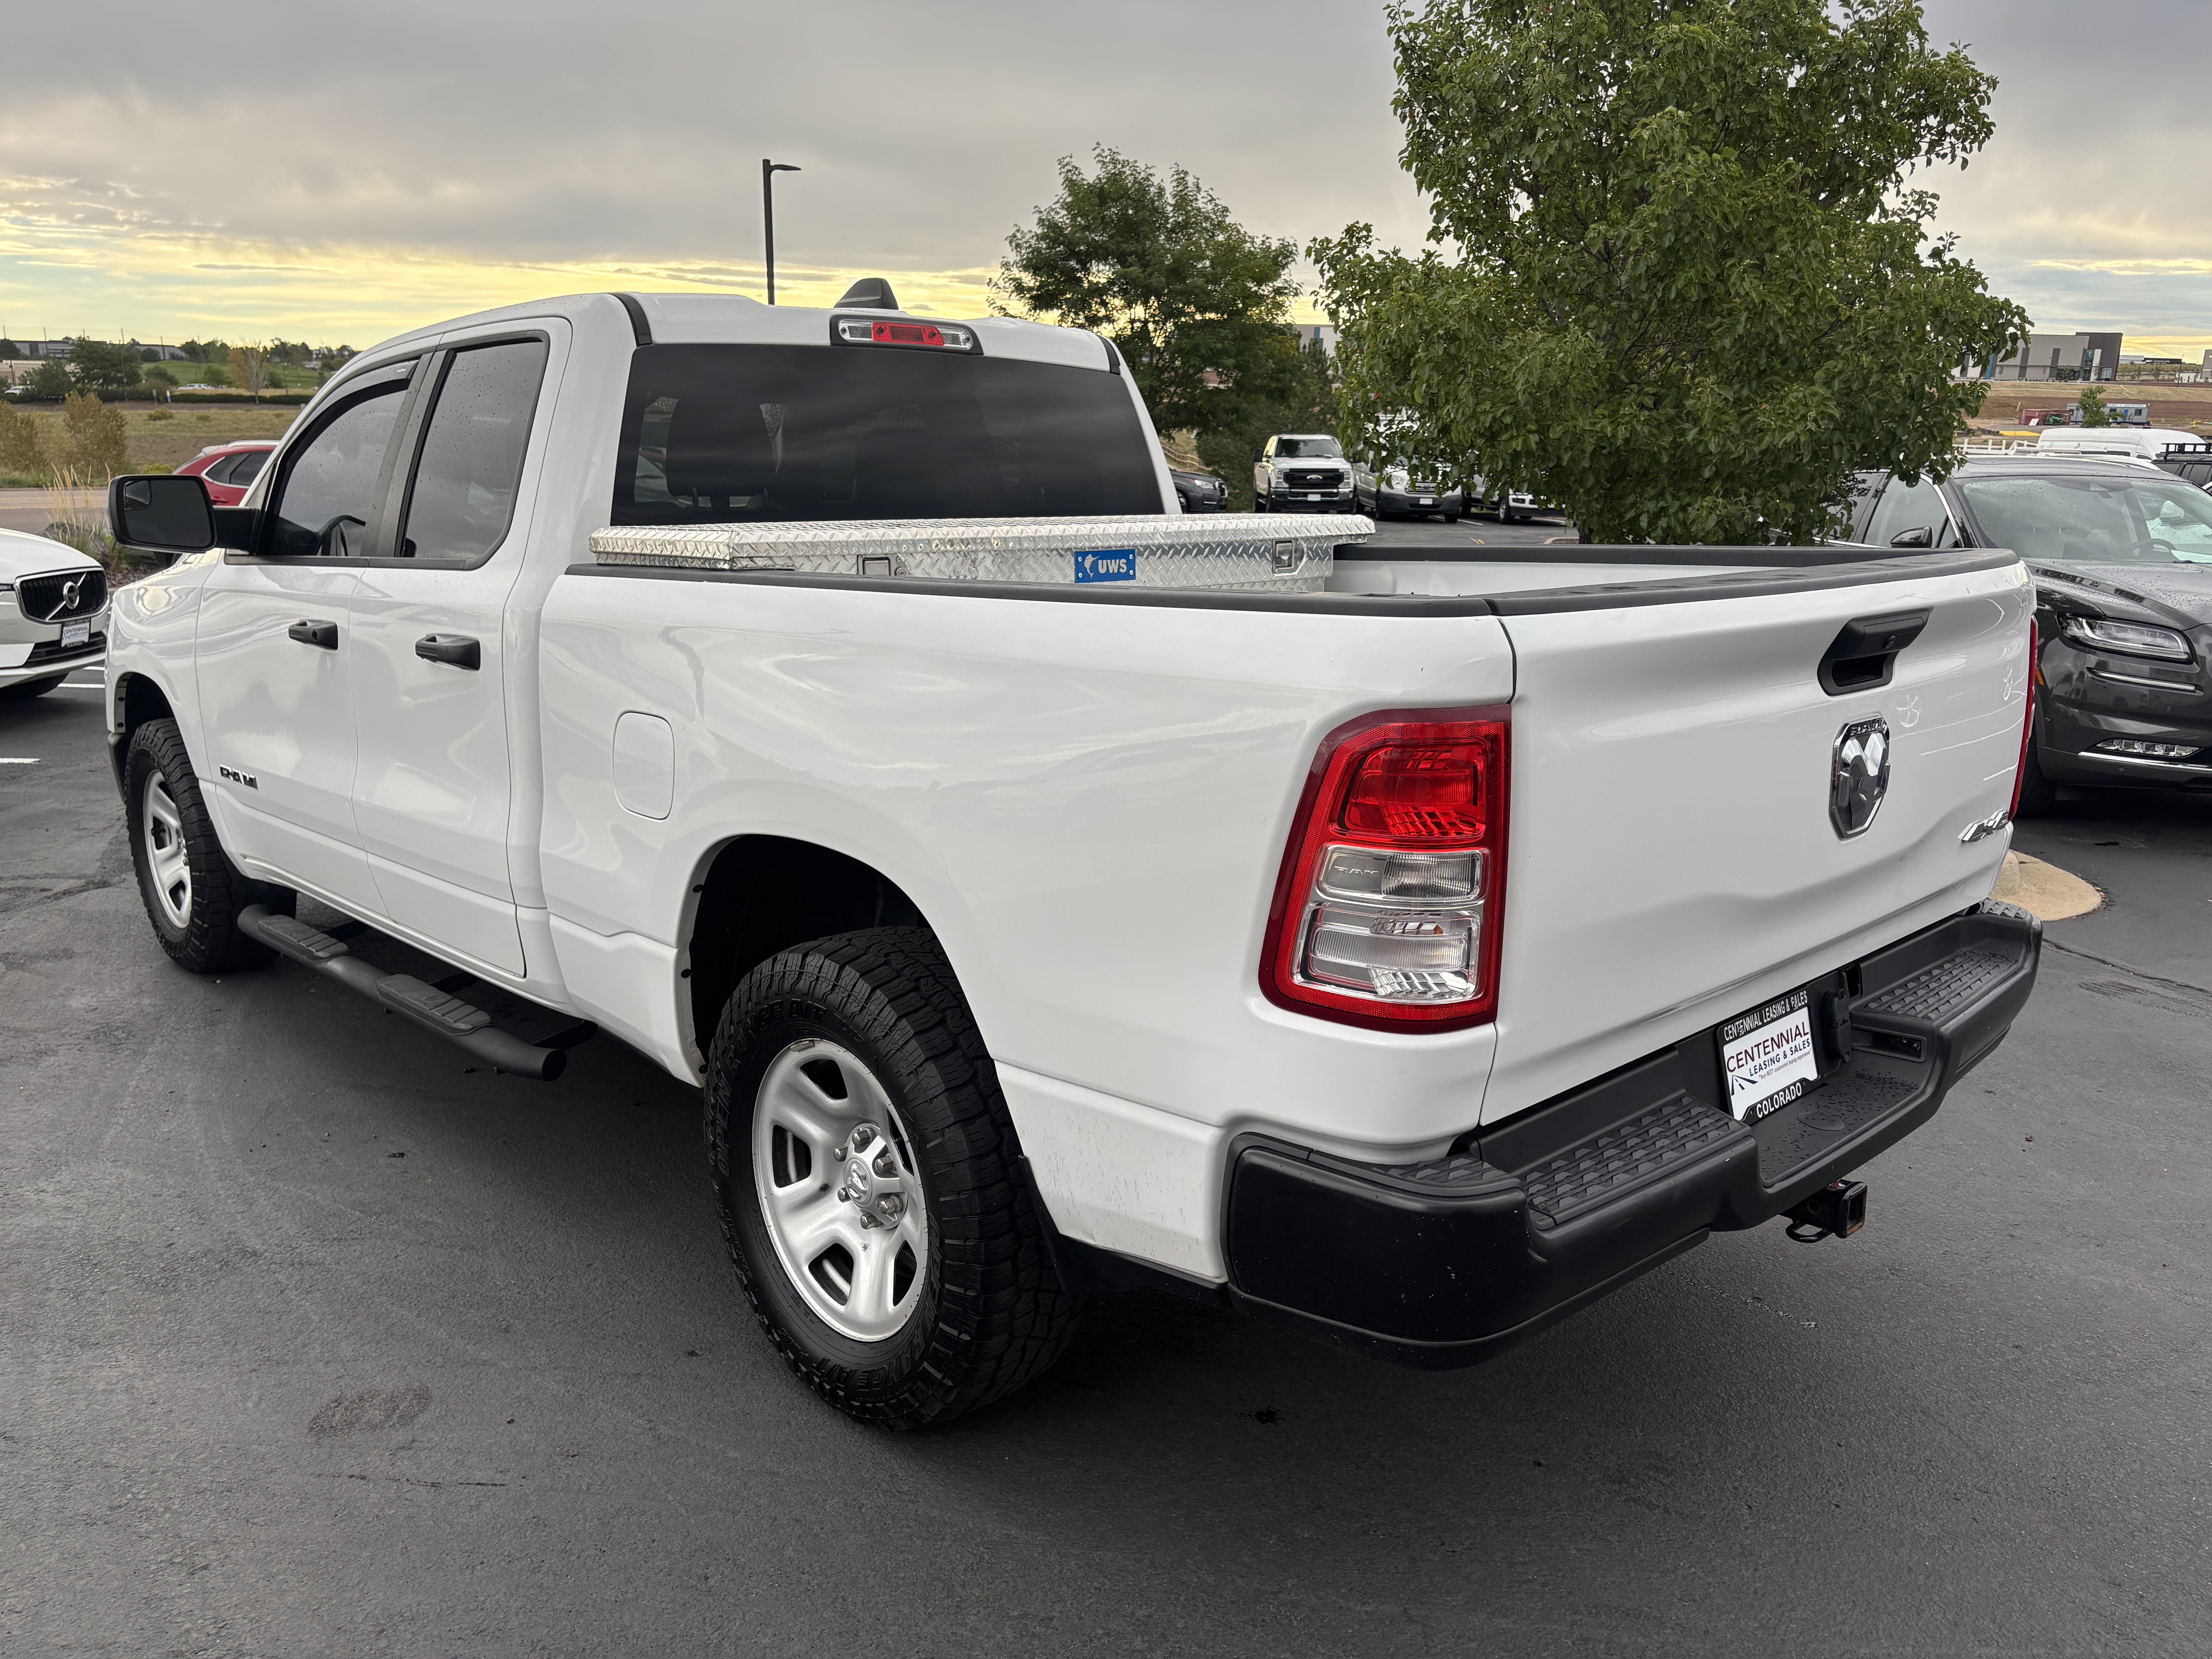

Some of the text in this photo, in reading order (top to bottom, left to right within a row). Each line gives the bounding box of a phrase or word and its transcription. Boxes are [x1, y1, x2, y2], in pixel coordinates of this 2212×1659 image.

[1098, 558, 1127, 574] UWS
[220, 764, 258, 790] RAM
[1334, 866, 1379, 877] RAM
[1724, 990, 1808, 1041] CENTENNIAL LEASING & SALES
[1726, 1021, 1809, 1073] CENTENNIAL
[1749, 1038, 1810, 1077] LEASING & SALES
[716, 1072, 734, 1177] OPEN
[726, 998, 783, 1077] RANGE
[787, 998, 827, 1023] A/T
[1756, 1082, 1802, 1118] COLORADO
[854, 1319, 926, 1393] RANGE
